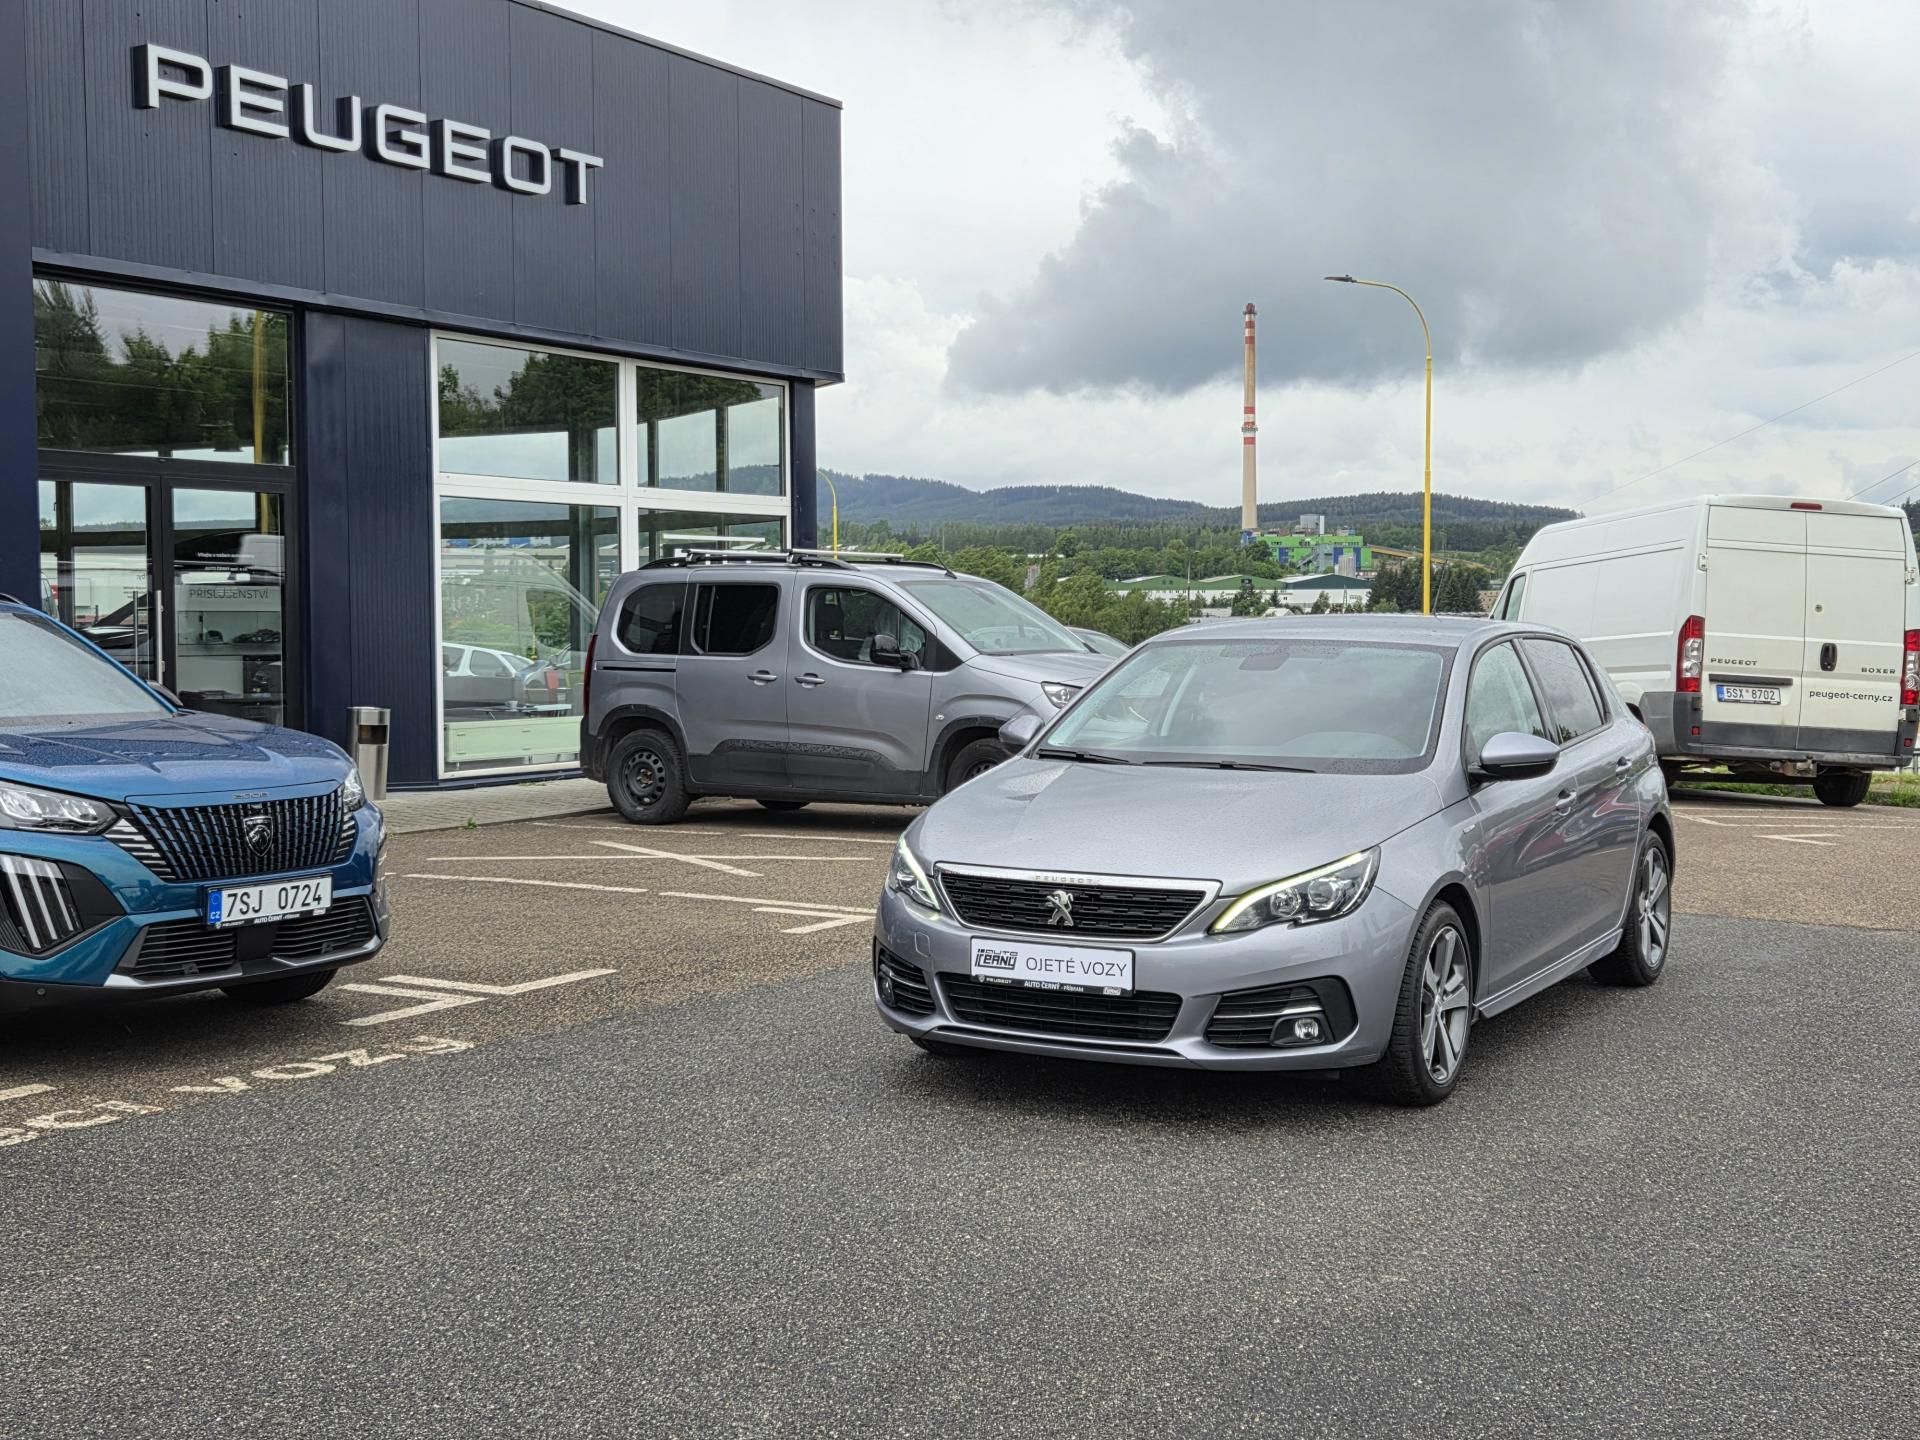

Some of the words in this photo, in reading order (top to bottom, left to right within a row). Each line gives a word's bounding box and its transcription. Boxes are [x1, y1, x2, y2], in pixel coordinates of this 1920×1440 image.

[133, 42, 604, 206] PEUGEOT
[1710, 657, 1758, 667] PEUGEOT
[1861, 667, 1896, 675] BOXER
[1726, 687, 1744, 699] 5SX
[1751, 689, 1775, 701] 8702
[1809, 689, 1893, 702] peugeot-cerny.cz
[1035, 875, 1093, 885] PEUGEOT
[226, 889, 263, 917] 7SJ
[278, 882, 322, 910] 0724
[209, 910, 221, 920] CZ
[1025, 957, 1076, 974] OJETÉ
[1080, 961, 1127, 977] VOZY
[1024, 980, 1040, 989] AUTO
[1041, 981, 1060, 990] ČERNÝ
